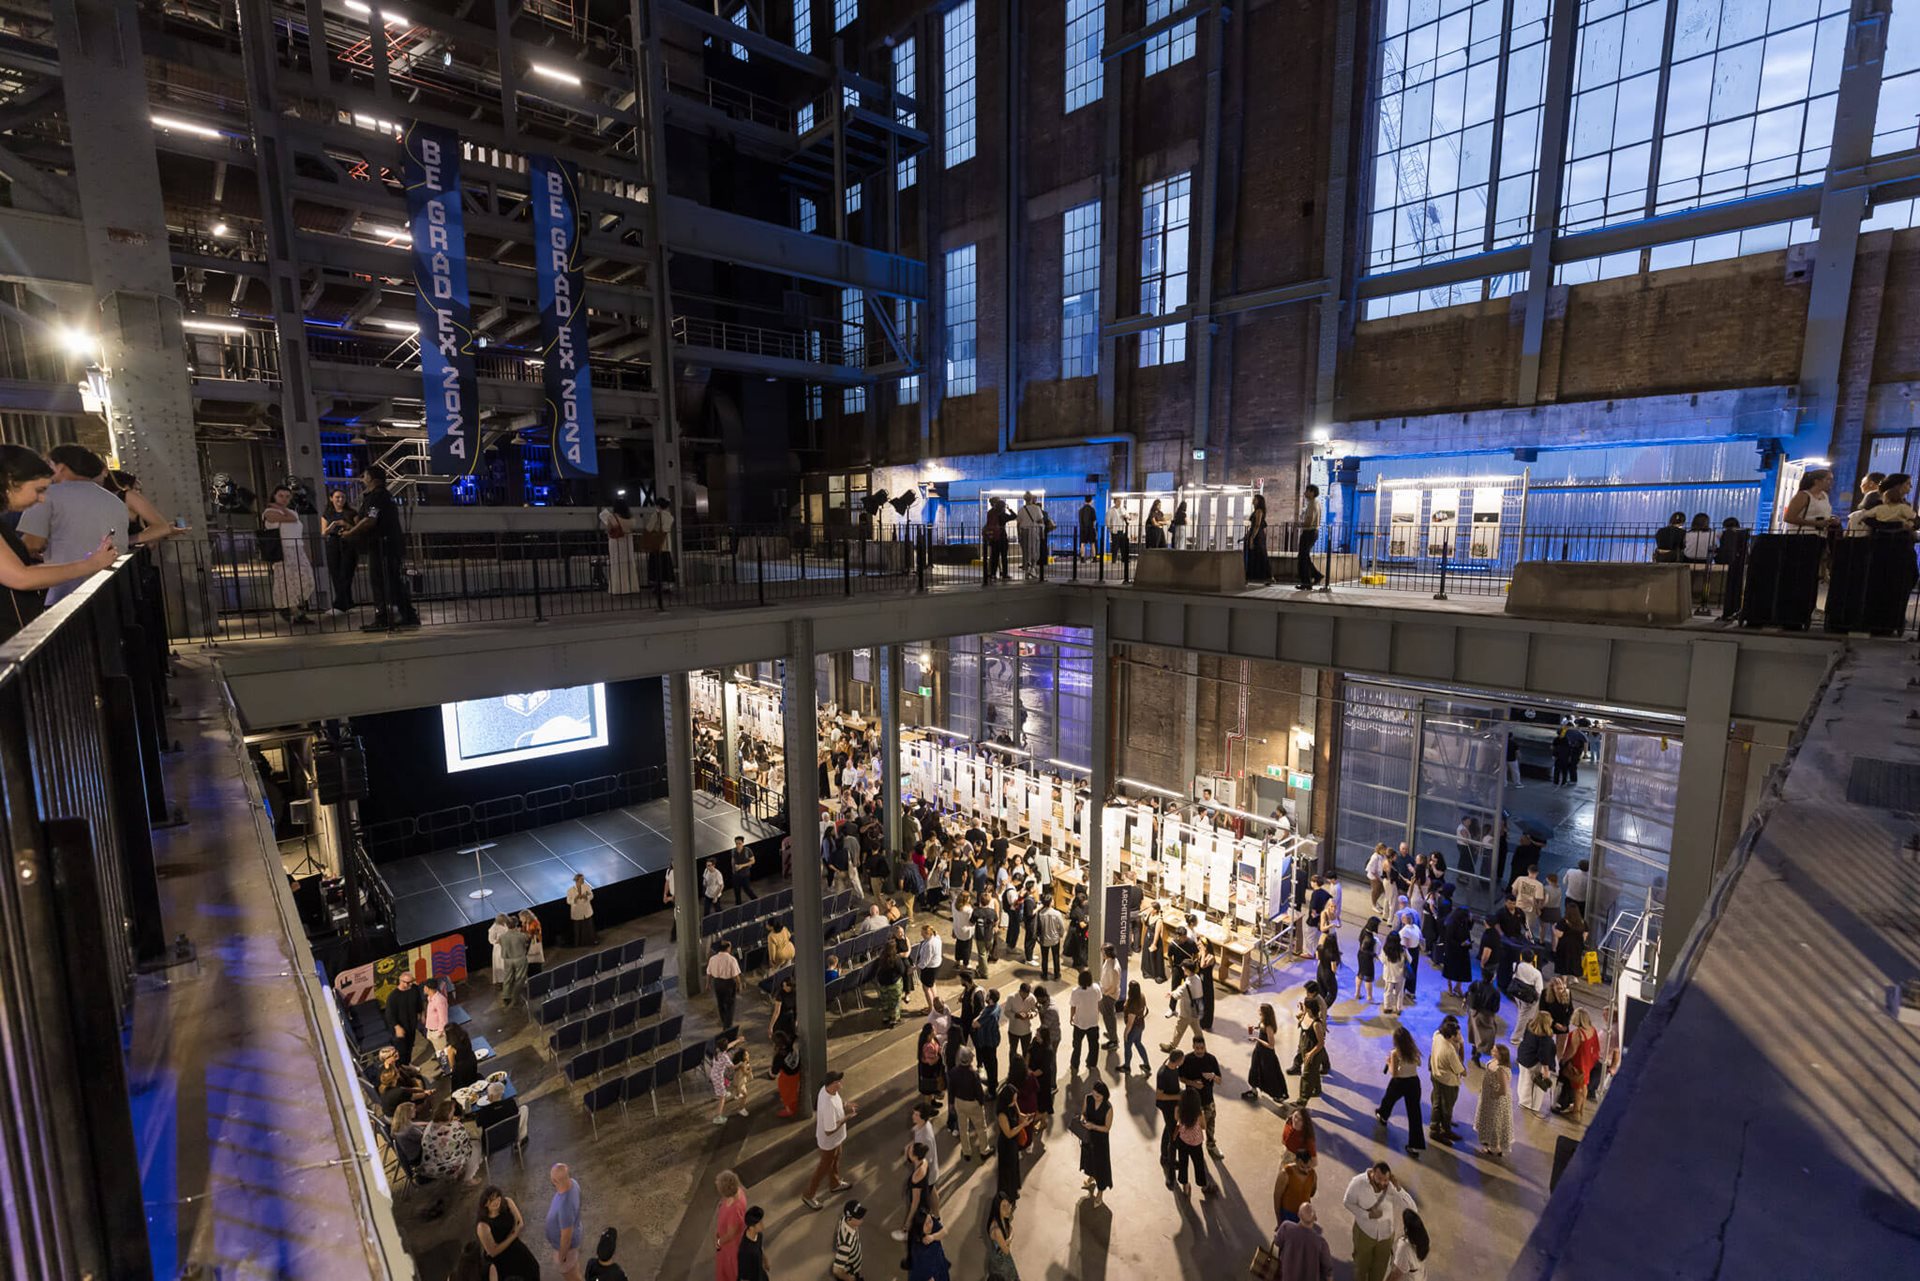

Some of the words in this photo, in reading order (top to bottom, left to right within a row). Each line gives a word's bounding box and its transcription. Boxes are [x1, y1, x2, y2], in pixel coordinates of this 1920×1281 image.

[422, 138, 441, 191] BE
[547, 171, 564, 220] BE
[427, 201, 452, 299] GRAD
[550, 228, 571, 317] GRAD
[437, 309, 457, 357] EX
[558, 327, 575, 371] EX
[441, 367, 465, 459] 2024
[561, 379, 581, 464] 2024
[1119, 889, 1128, 945] ARCHITECTURE
